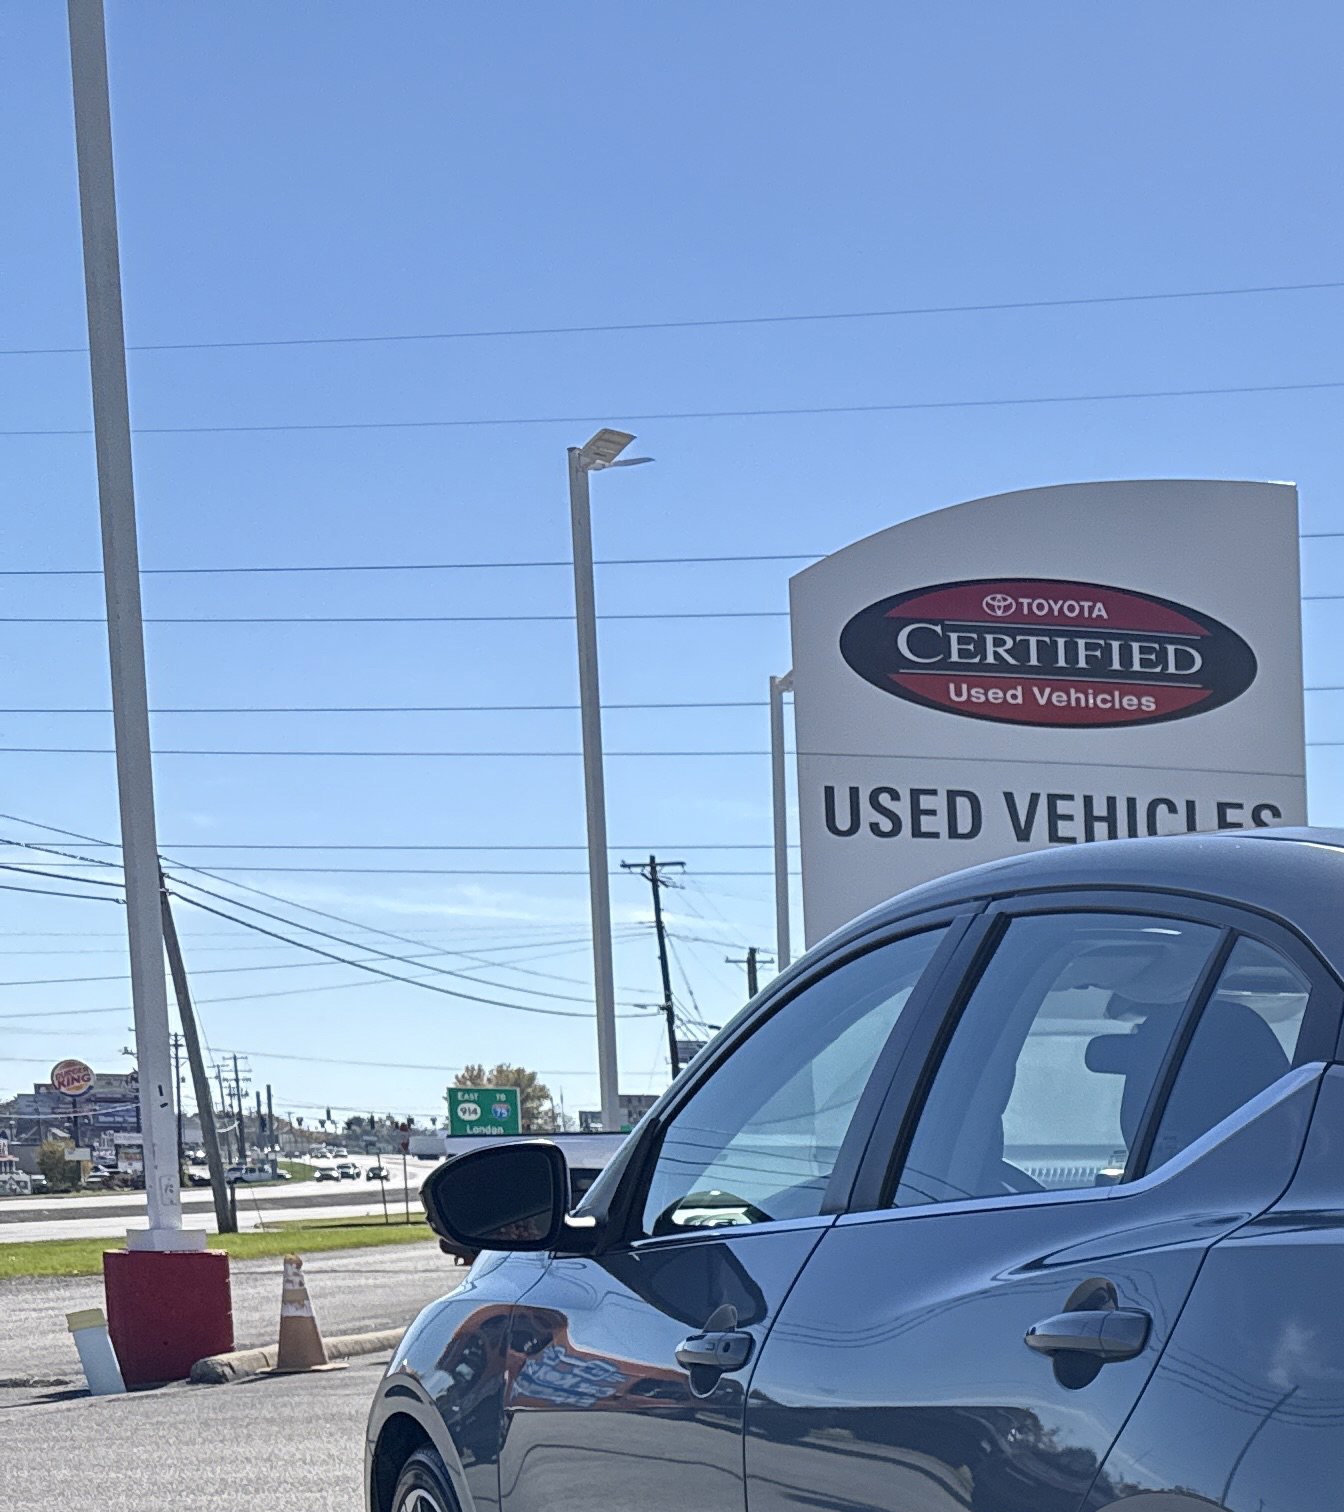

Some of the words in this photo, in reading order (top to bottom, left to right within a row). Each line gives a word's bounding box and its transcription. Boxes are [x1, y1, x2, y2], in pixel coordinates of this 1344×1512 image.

[1018, 597, 1109, 620] TOYOTA
[897, 622, 1203, 675] CERTIFIED
[948, 682, 1024, 706] Used
[1032, 686, 1157, 711] Vehicles
[823, 785, 983, 840] USED
[57, 1073, 91, 1090] KING
[457, 1092, 478, 1101] EAST
[496, 1093, 506, 1101] TO
[460, 1107, 478, 1116] 914
[495, 1109, 508, 1117] 75
[466, 1125, 504, 1135] London
